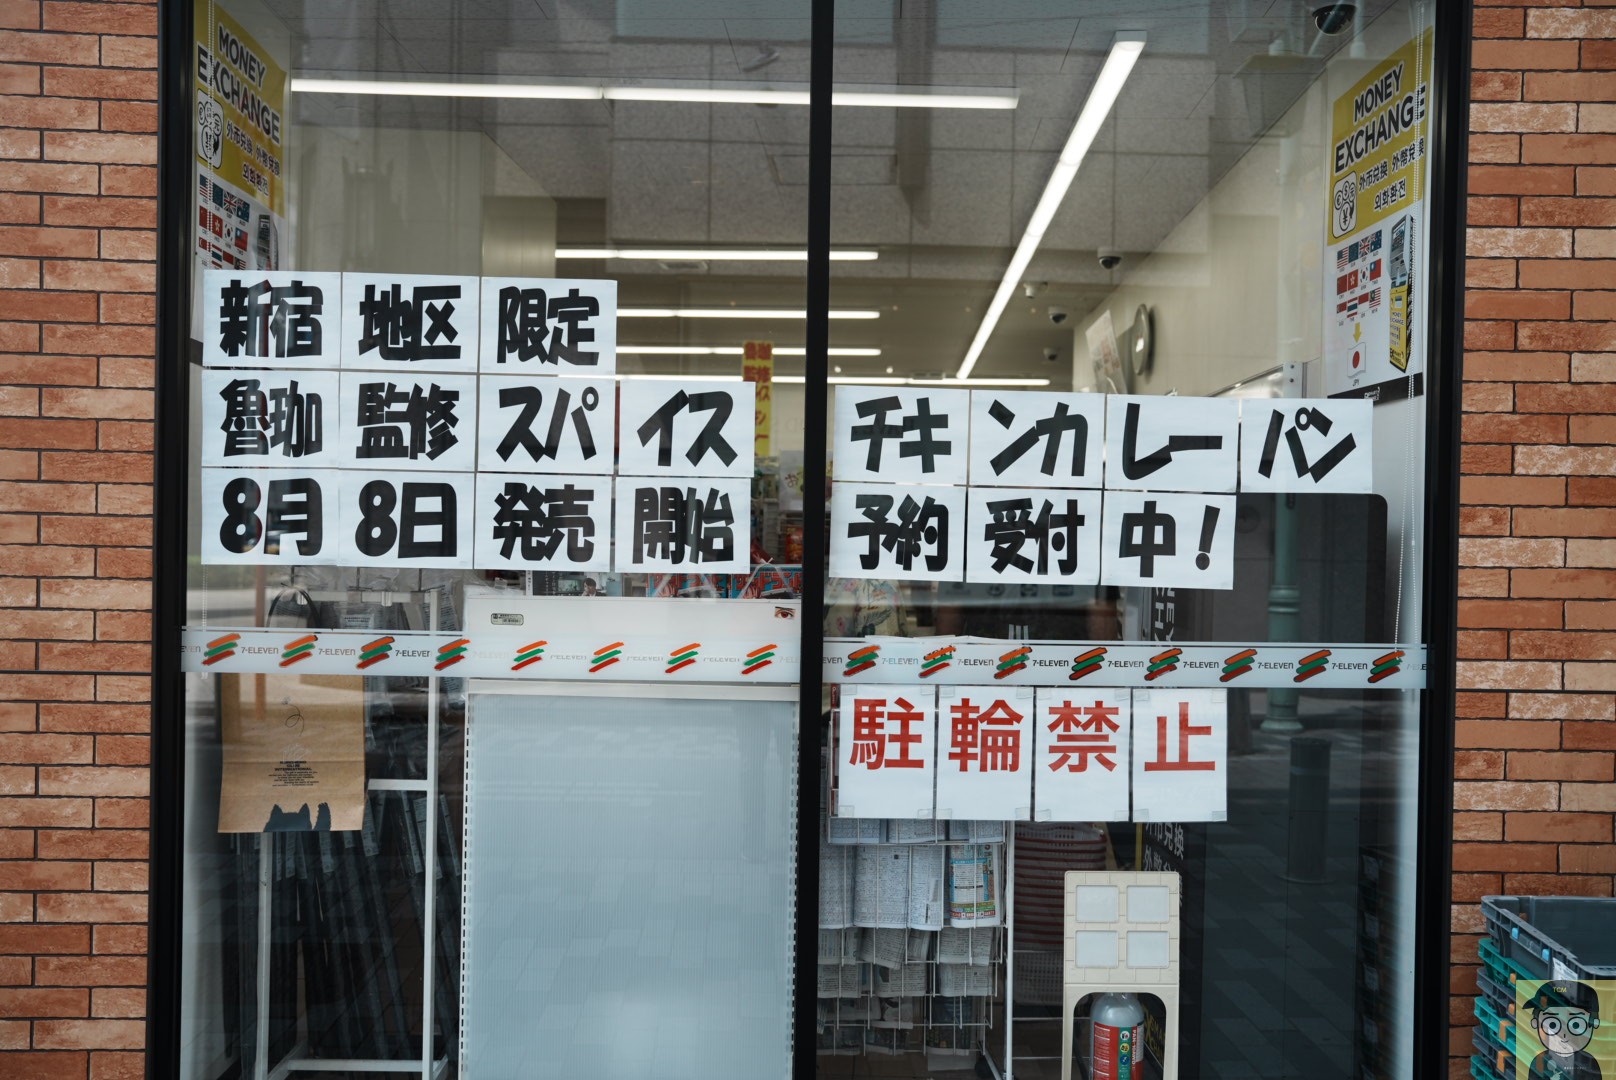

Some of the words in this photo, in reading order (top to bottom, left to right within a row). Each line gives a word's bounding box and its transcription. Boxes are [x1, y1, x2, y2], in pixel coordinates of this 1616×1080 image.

[197, 45, 280, 144] EXCHANGE
[218, 25, 265, 88] MONEY
[1354, 63, 1404, 122] MONEY
[1335, 85, 1426, 174] EXCHANGE
[1374, 179, 1406, 211] 외화환전
[219, 278, 600, 366] 新宿地区限定
[219, 378, 738, 467] 魯珈監修スパイス
[850, 395, 1357, 484] チキンカレーパン
[219, 477, 735, 565] 8月8日発売開始
[849, 697, 1216, 773] 駐輪禁止
